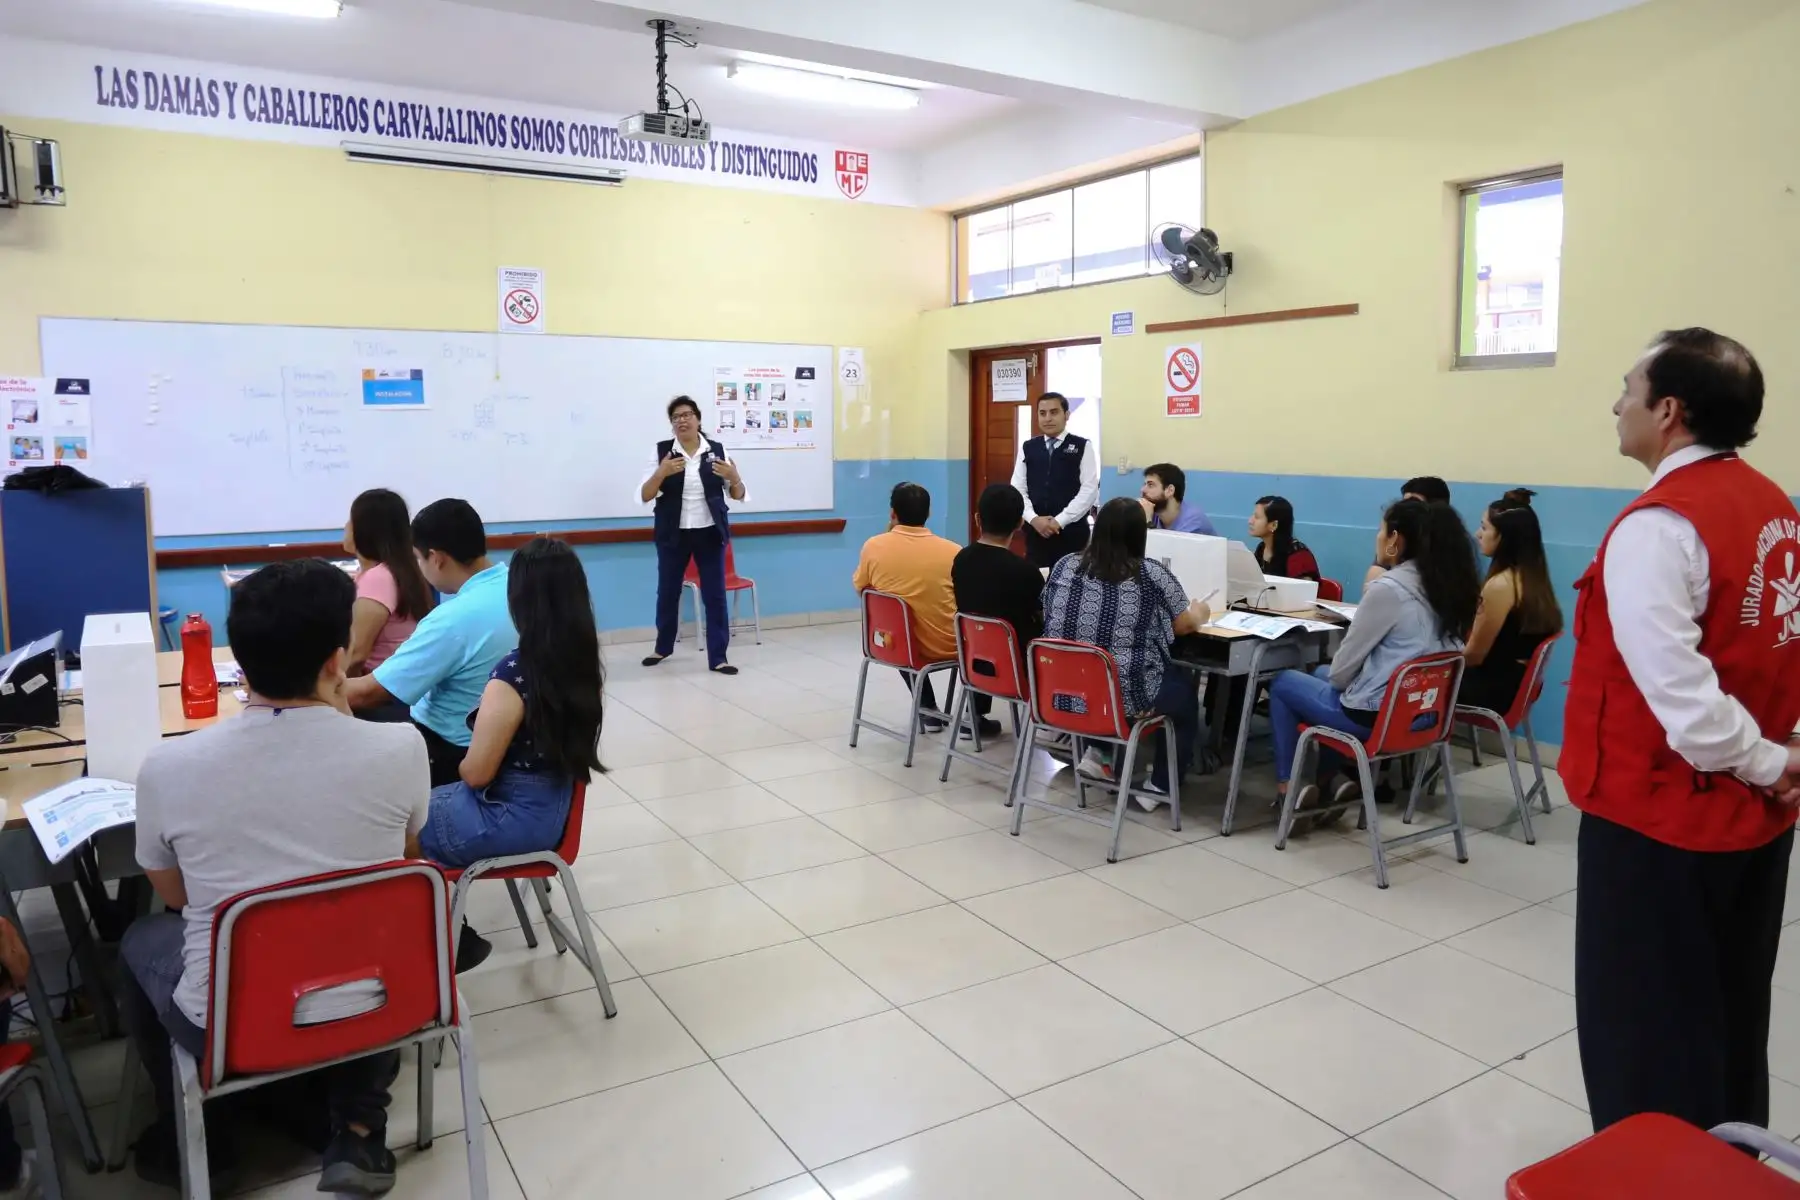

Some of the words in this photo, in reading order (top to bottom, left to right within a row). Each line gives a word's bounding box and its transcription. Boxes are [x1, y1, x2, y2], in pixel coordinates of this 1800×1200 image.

[93, 65, 139, 110] LAS
[143, 71, 220, 118] DAMAS
[223, 80, 238, 120] Y
[243, 83, 370, 135] CABALLEROS
[373, 98, 507, 149] CARVAJALINOS
[510, 115, 565, 155] SOMOS
[650, 140, 705, 170] NOBLES
[708, 140, 719, 172] Y
[721, 141, 818, 184] DISTINGUIDOS
[846, 368, 858, 378] 23
[997, 367, 1022, 379] 030390
[1740, 563, 1764, 627] JURADO
